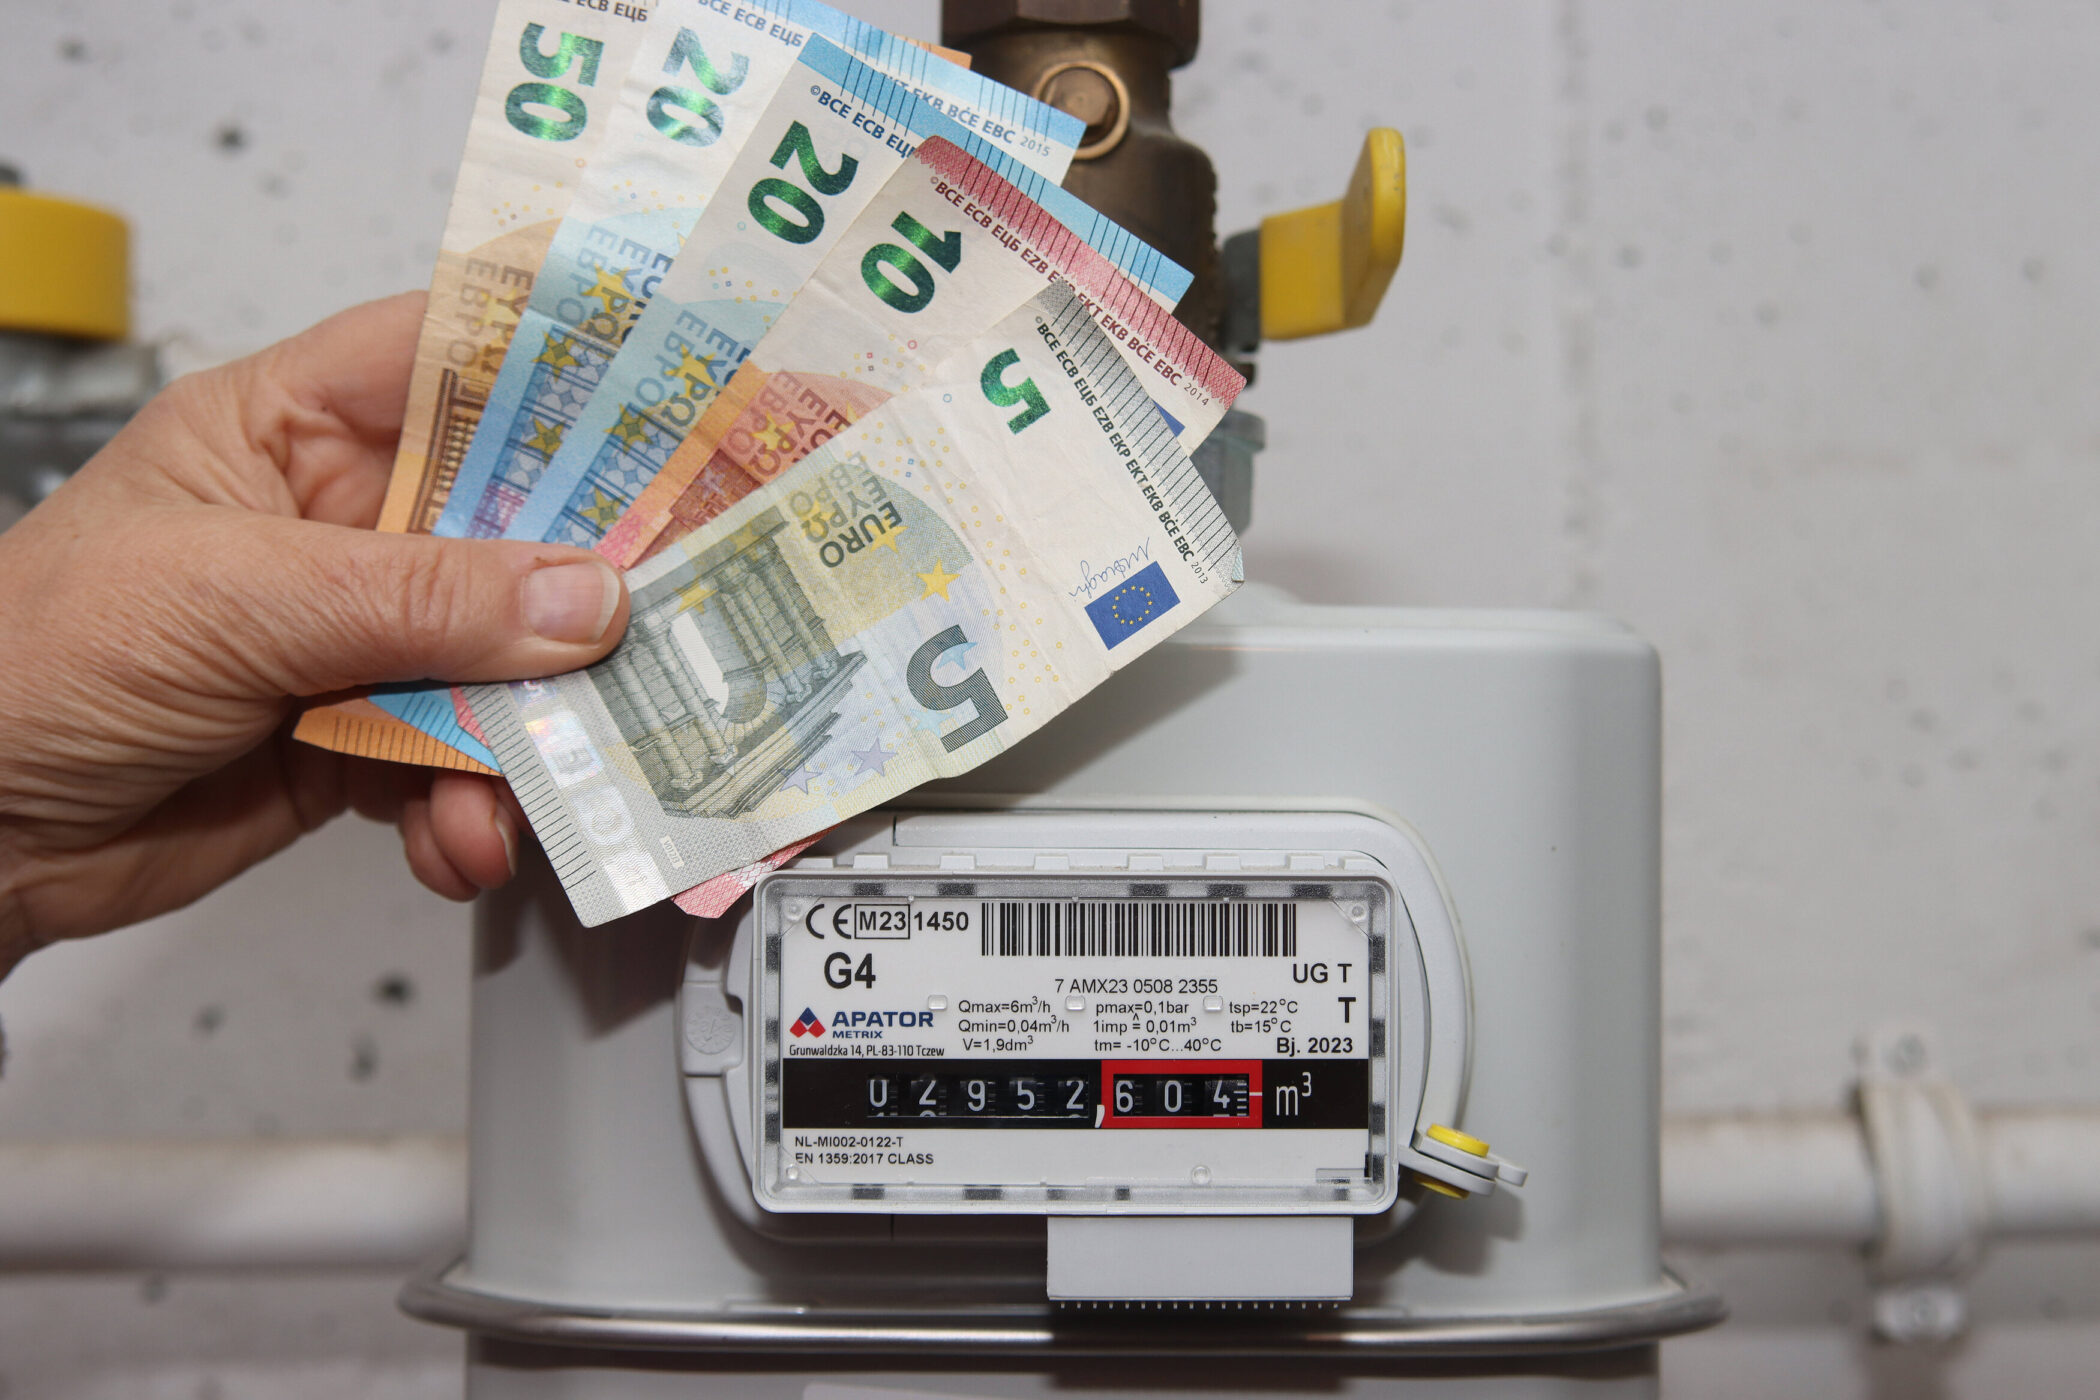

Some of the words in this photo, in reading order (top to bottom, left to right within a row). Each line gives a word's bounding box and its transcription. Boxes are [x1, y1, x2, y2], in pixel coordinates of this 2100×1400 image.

[733, 8, 767, 31] ECB
[505, 22, 604, 142] 50
[646, 26, 750, 147] 20
[852, 113, 885, 139] ECB
[982, 120, 1016, 144] EBC
[1020, 136, 1050, 157] 2015
[747, 120, 859, 244] 20
[860, 211, 961, 314] 10
[963, 202, 993, 228] ECB
[1020, 247, 1049, 274] EZB
[1100, 314, 1129, 341] EKB
[1152, 359, 1183, 386] EBC
[1184, 383, 1209, 406] 2014
[980, 347, 1051, 435] 5
[1056, 350, 1080, 378] ECB
[1092, 406, 1114, 433] EZB
[1109, 432, 1131, 458] EKP
[1142, 484, 1164, 512] EKB
[1174, 535, 1195, 561] EBC
[1191, 561, 1209, 584] 2013
[819, 501, 902, 568] EURO
[906, 624, 1009, 754] 5
[806, 904, 852, 939] CE
[859, 911, 906, 931] M23
[914, 911, 969, 931] 1450
[824, 952, 876, 989] G4
[1292, 963, 1329, 983] UG
[1337, 963, 1352, 983] T
[1054, 979, 1064, 994] 7
[1069, 979, 1128, 994] AMX23
[1133, 979, 1173, 994] 0508
[1178, 979, 1218, 994] 2355
[832, 1011, 934, 1027] APATOR
[1096, 1000, 1189, 1016] pmax=0,1bar
[1229, 999, 1298, 1016] tsp=22°C
[1338, 997, 1356, 1023] T
[832, 1030, 882, 1039] METRIX
[1093, 1020, 1127, 1035] 1imp
[789, 1044, 848, 1056] Grunwaldzka
[850, 1044, 864, 1058] 14,
[866, 1044, 914, 1056] PL-83-110
[916, 1044, 945, 1056] Tczew
[1094, 1039, 1121, 1052] tm=
[1276, 1037, 1301, 1057] Bj.
[1308, 1037, 1353, 1053] 2023
[795, 1136, 903, 1148] NL-MI002-0122-T
[795, 1153, 813, 1164] EN
[818, 1153, 883, 1164] 1359:2017
[887, 1153, 934, 1164] CLASS
